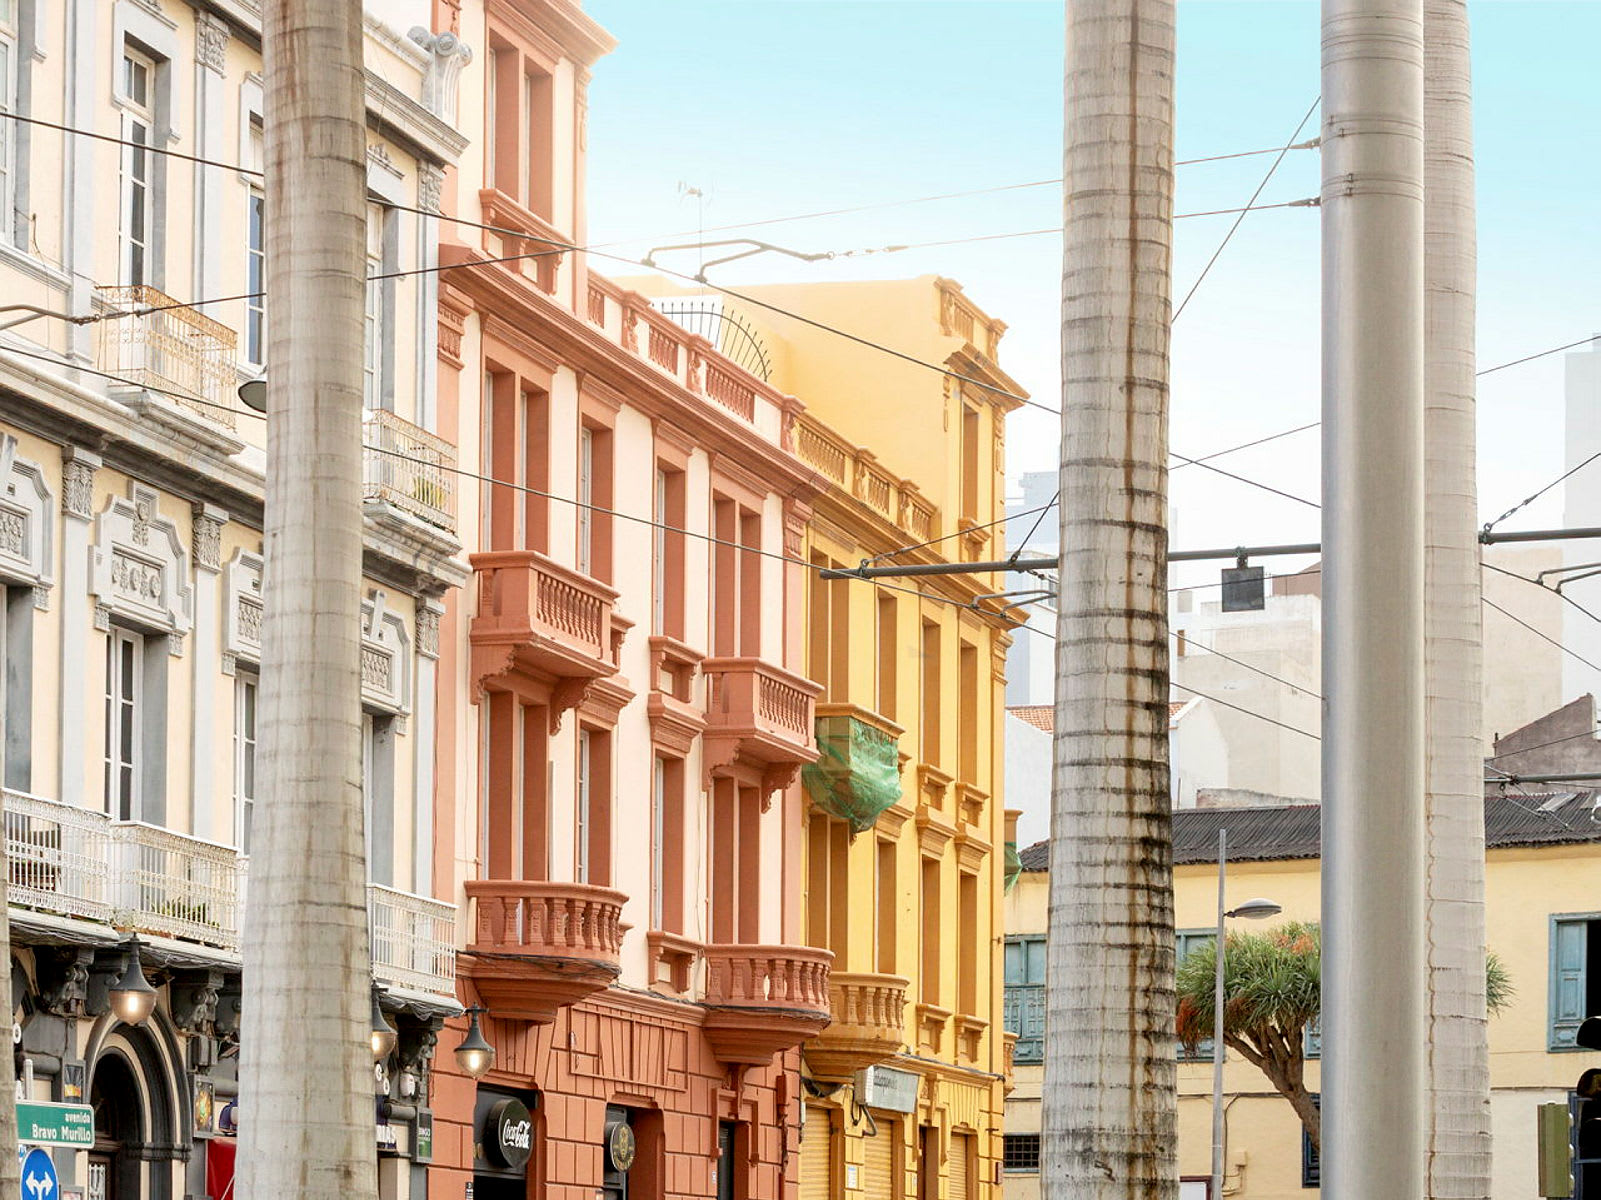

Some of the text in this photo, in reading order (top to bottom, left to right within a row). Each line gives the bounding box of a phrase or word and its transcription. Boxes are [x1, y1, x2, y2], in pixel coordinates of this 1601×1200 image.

[65, 1112, 91, 1123] avenida
[32, 1123, 91, 1141] Bravo Murillo
